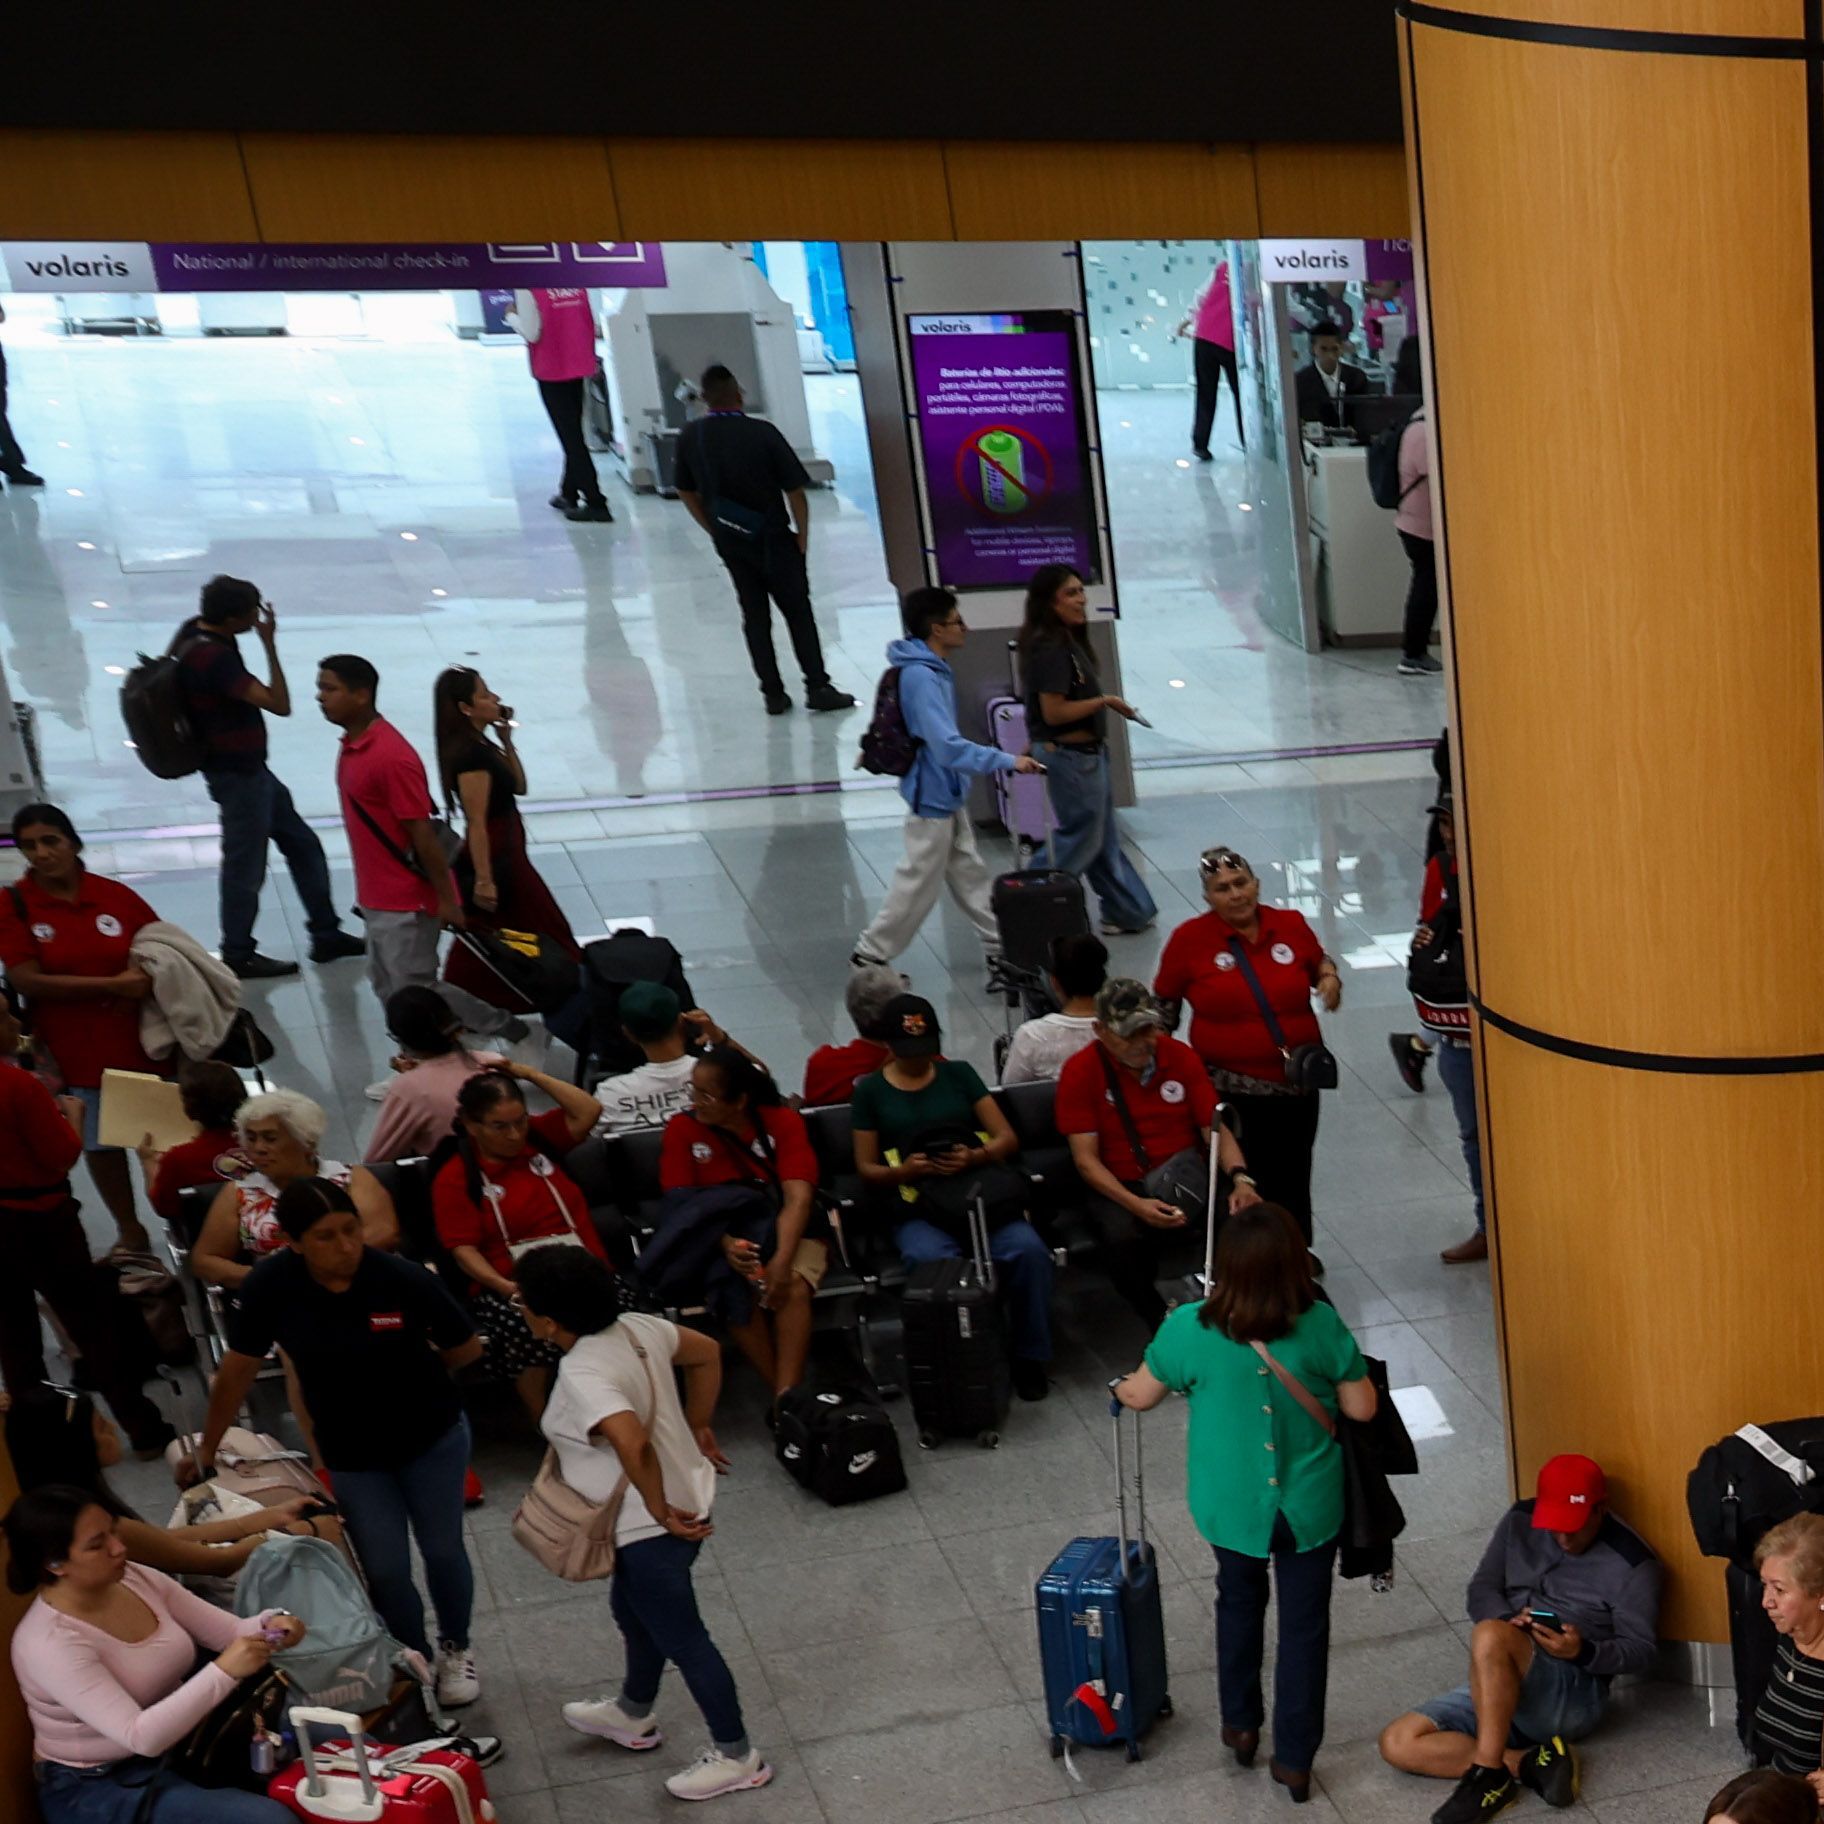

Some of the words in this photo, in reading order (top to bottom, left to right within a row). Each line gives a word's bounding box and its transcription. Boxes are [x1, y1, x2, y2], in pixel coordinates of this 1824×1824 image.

[26, 254, 129, 277] volaris
[173, 253, 254, 270] National
[1274, 249, 1349, 268] volaris
[920, 319, 972, 333] volaris
